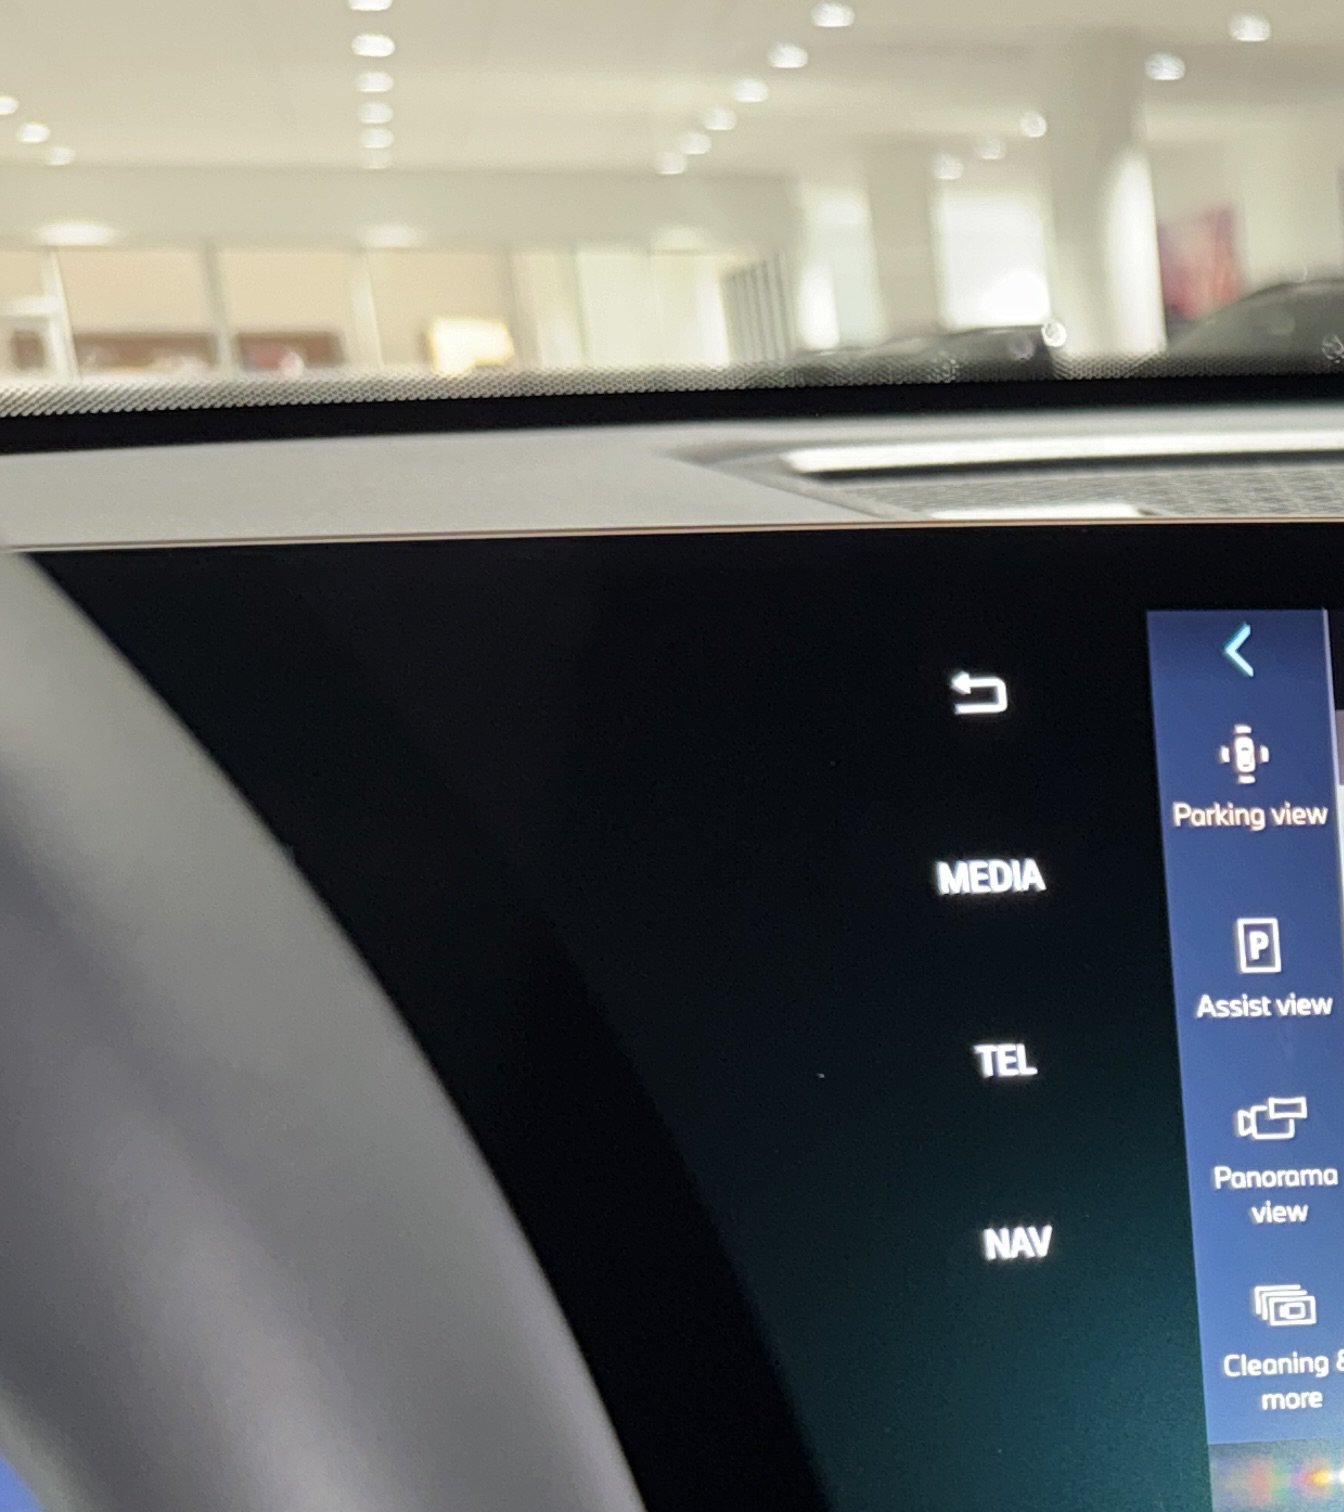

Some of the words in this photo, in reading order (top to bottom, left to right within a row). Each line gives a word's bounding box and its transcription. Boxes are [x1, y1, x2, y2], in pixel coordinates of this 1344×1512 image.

[1173, 801, 1265, 831] Parking
[1271, 803, 1328, 826] view
[936, 858, 1046, 894] MEDIA
[1196, 996, 1271, 1019] Assist
[1276, 993, 1333, 1016] view
[975, 1044, 1038, 1078] TEL
[1214, 1165, 1339, 1189] Panorama
[1251, 1200, 1309, 1224] view
[983, 1226, 1052, 1260] NAV
[1224, 1352, 1329, 1378] Cleaning
[1261, 1390, 1323, 1410] more
